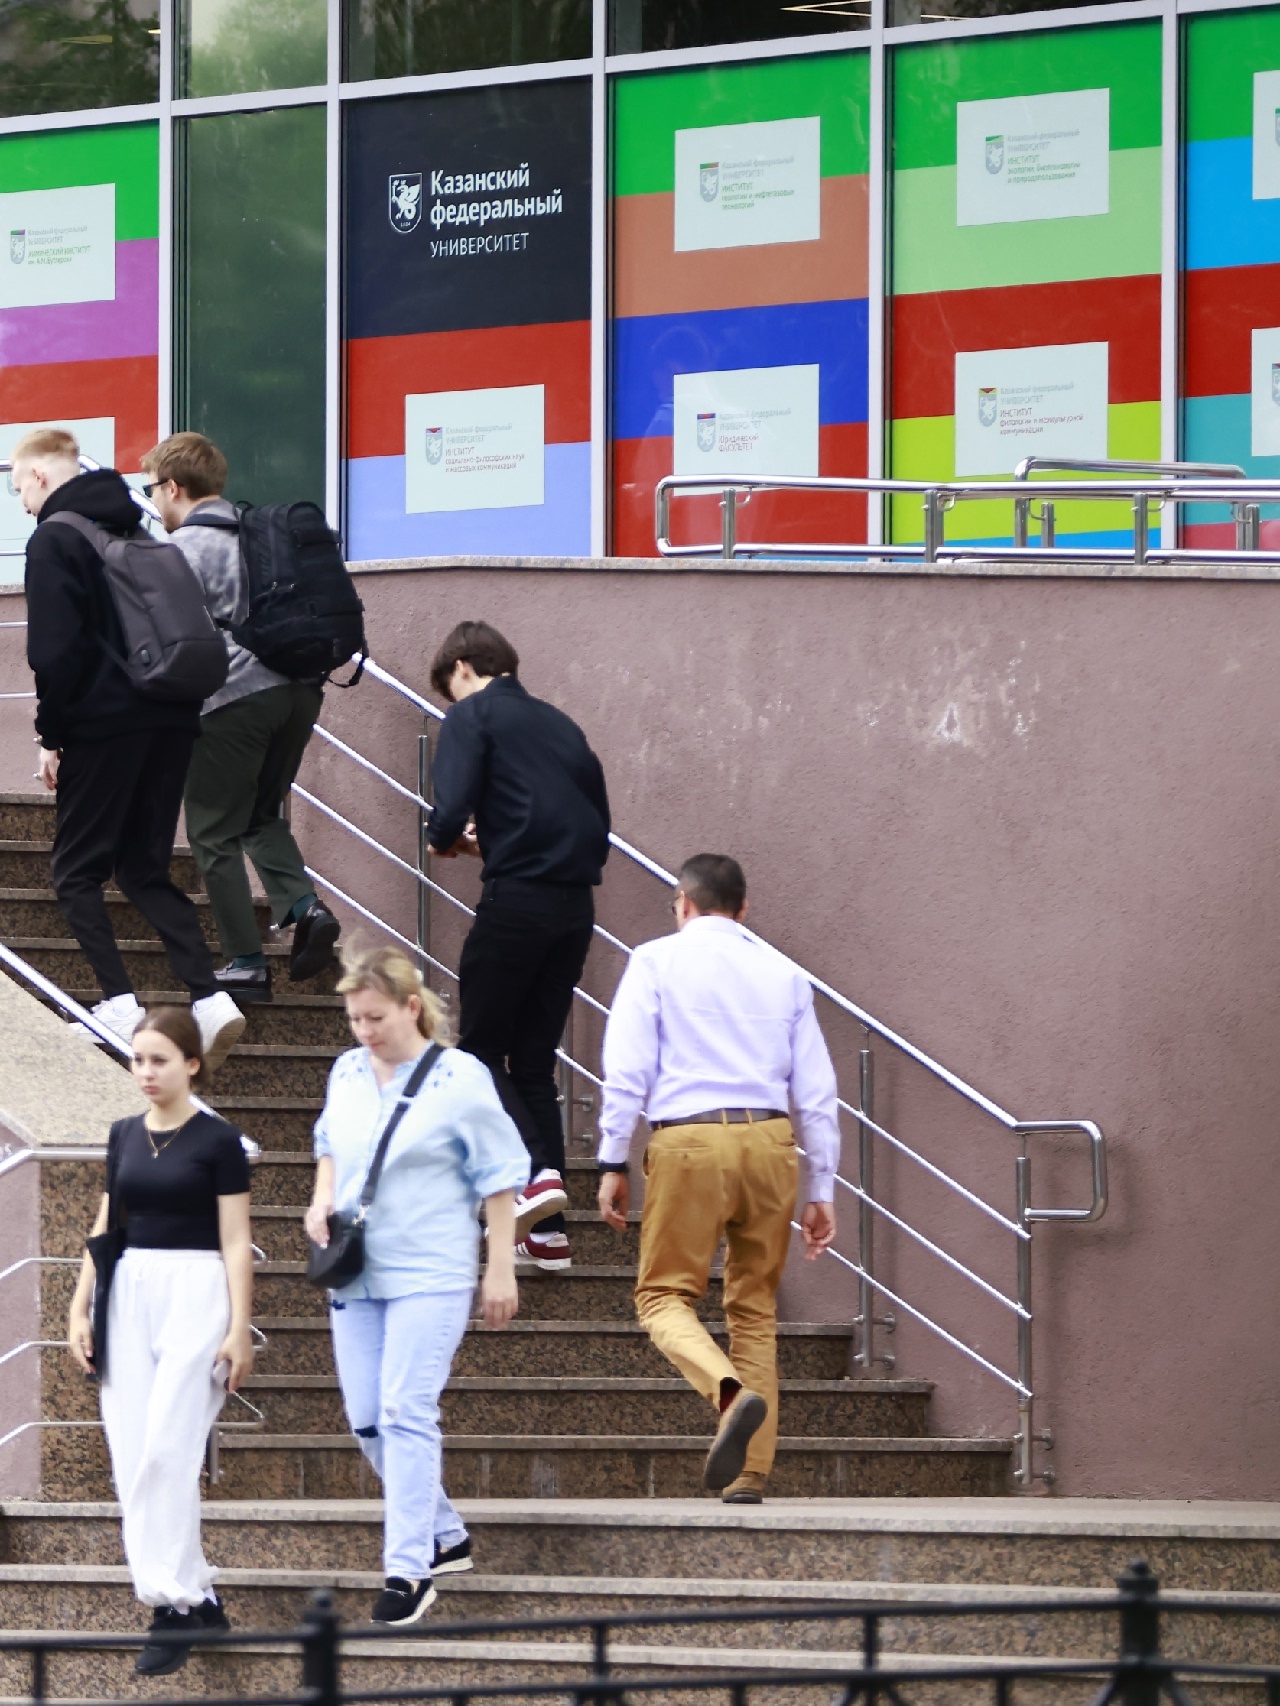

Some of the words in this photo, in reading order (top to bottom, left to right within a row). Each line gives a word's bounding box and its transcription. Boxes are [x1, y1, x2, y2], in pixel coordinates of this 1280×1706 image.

[430, 162, 530, 196] Казанский
[429, 188, 563, 230] федеральный
[430, 232, 529, 258] УНИВЕРСИТЕТ
